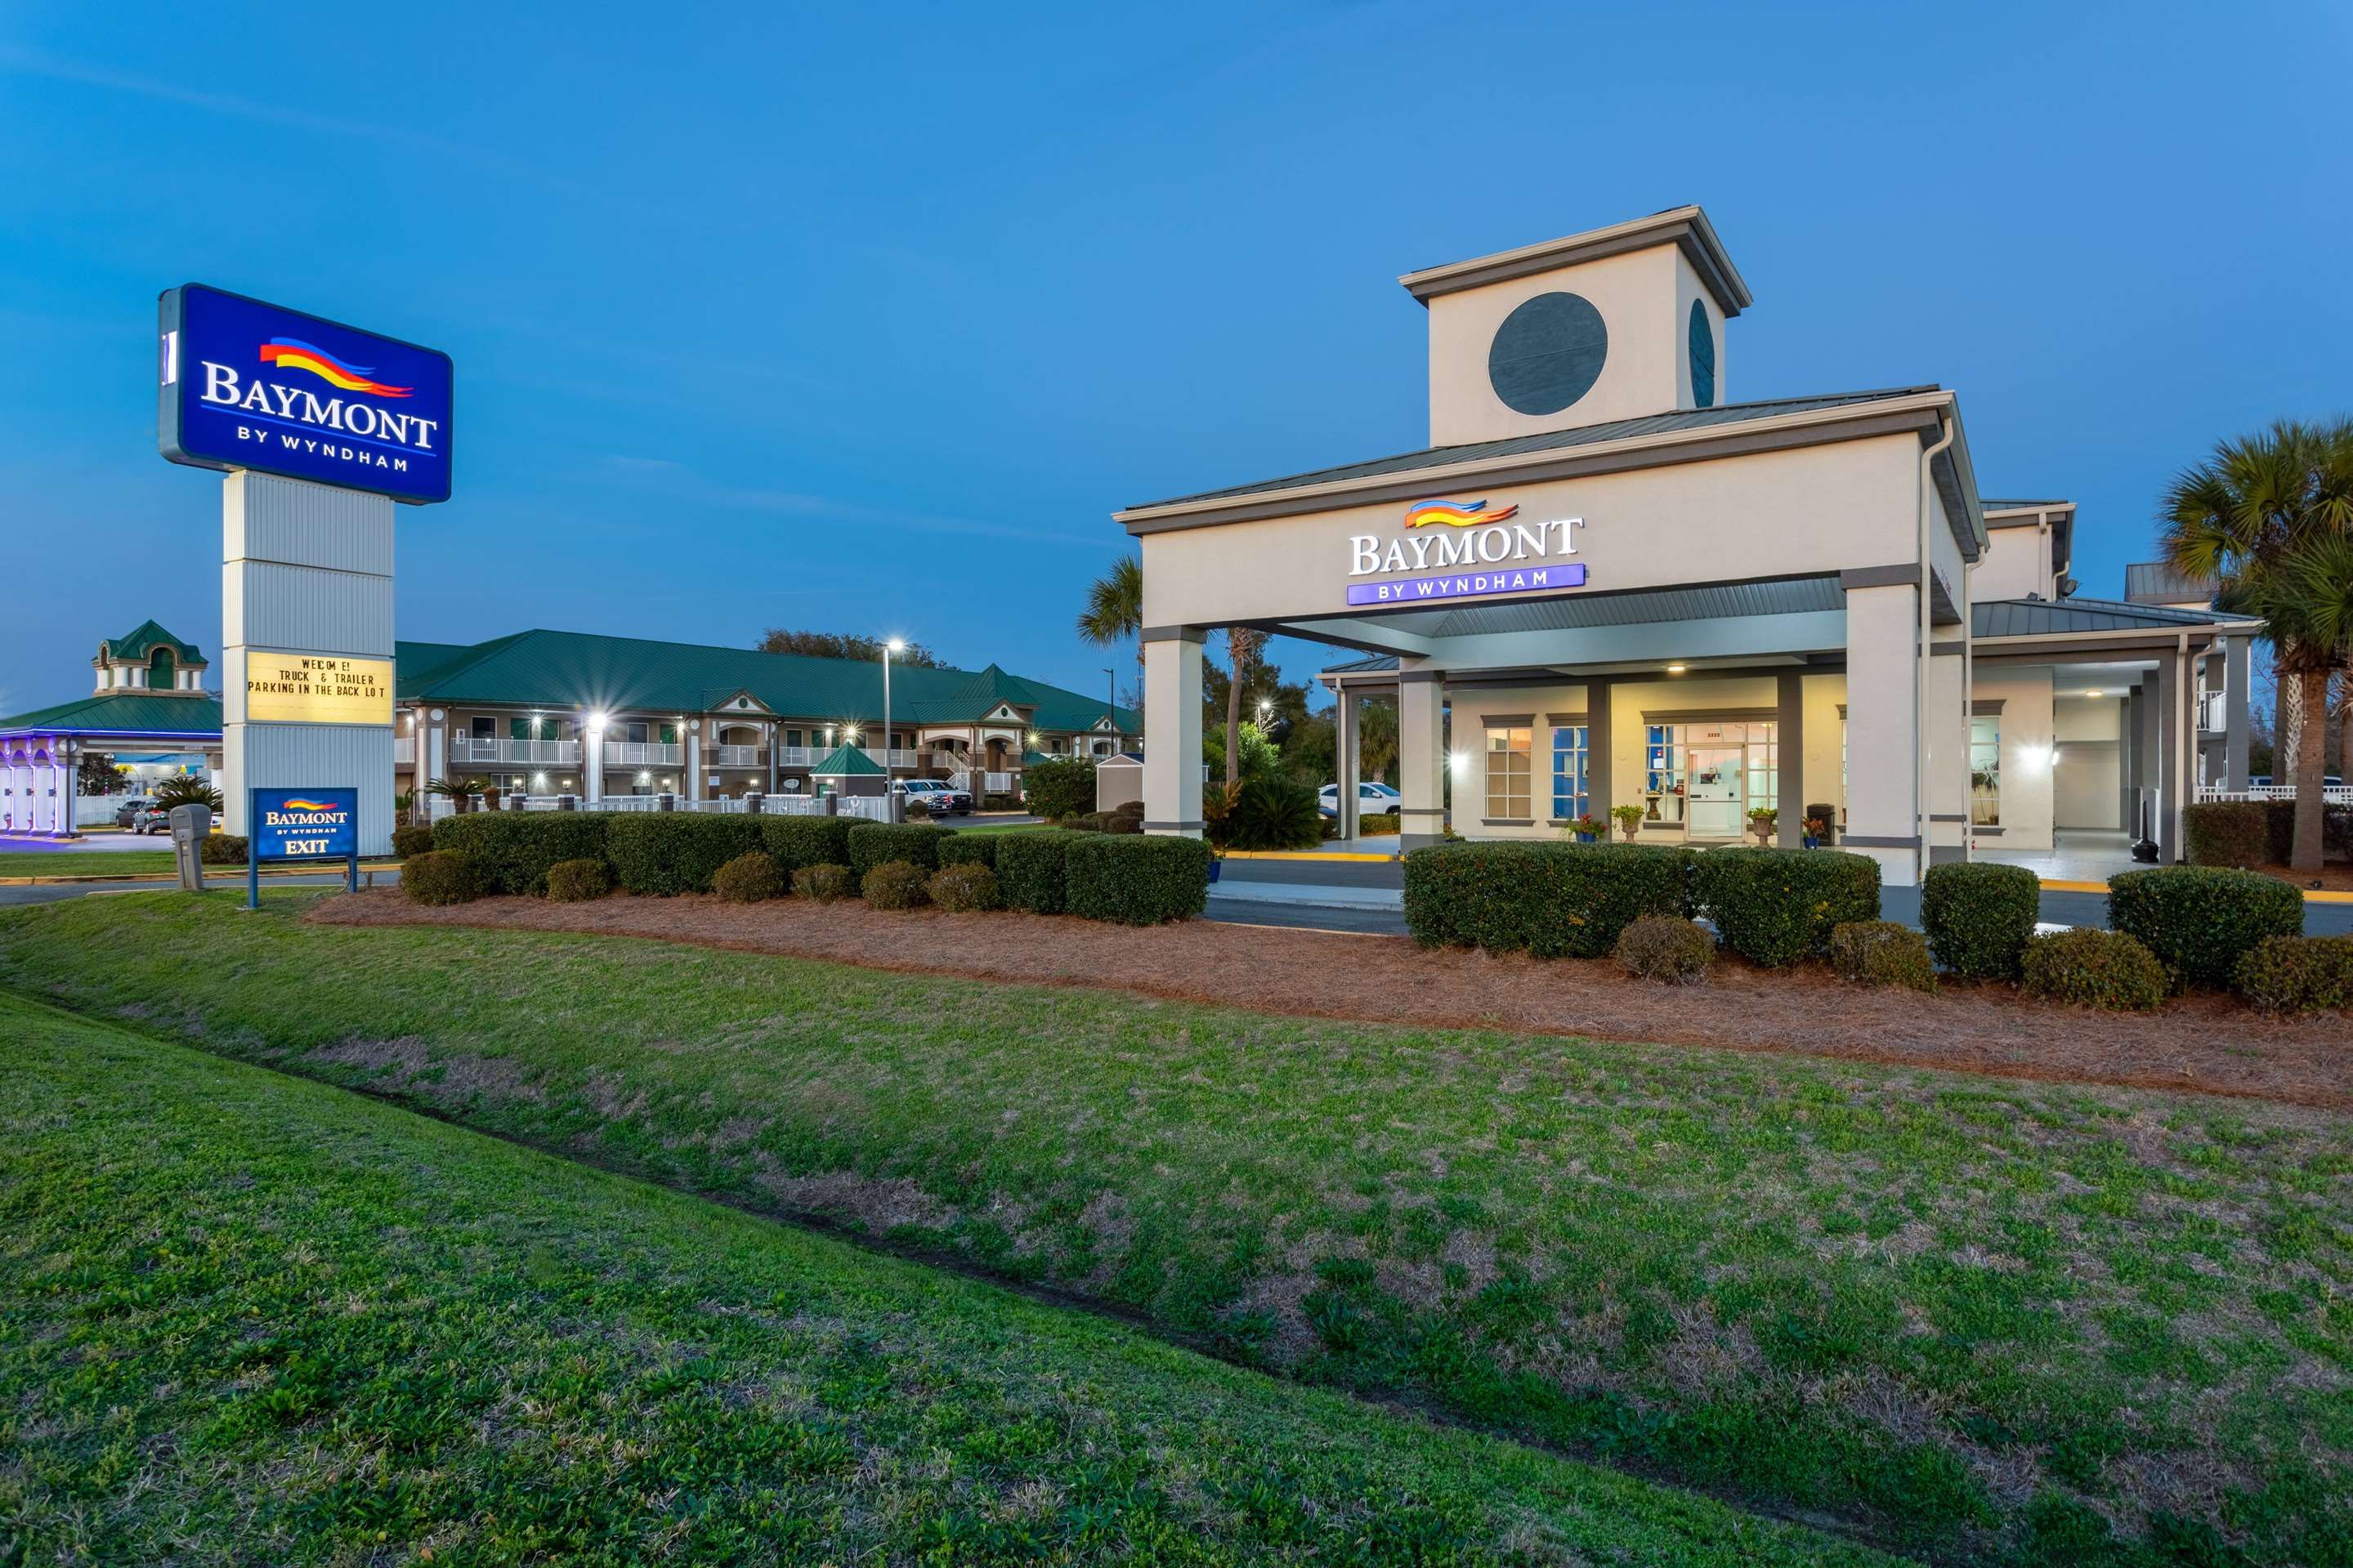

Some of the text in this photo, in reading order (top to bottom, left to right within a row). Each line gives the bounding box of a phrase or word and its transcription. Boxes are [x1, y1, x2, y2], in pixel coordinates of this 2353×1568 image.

[200, 360, 437, 449] BAYMONT
[238, 427, 407, 471] BY WYNDHAM
[1349, 516, 1584, 576] BAYMONT
[1379, 571, 1547, 599] BY WYNDHAM
[280, 670, 374, 685] TRUCK & TRAILER
[248, 681, 385, 698] PARKING IN THE BACK LOT
[265, 811, 347, 825] BAYMONT
[285, 839, 329, 855] EXIT
